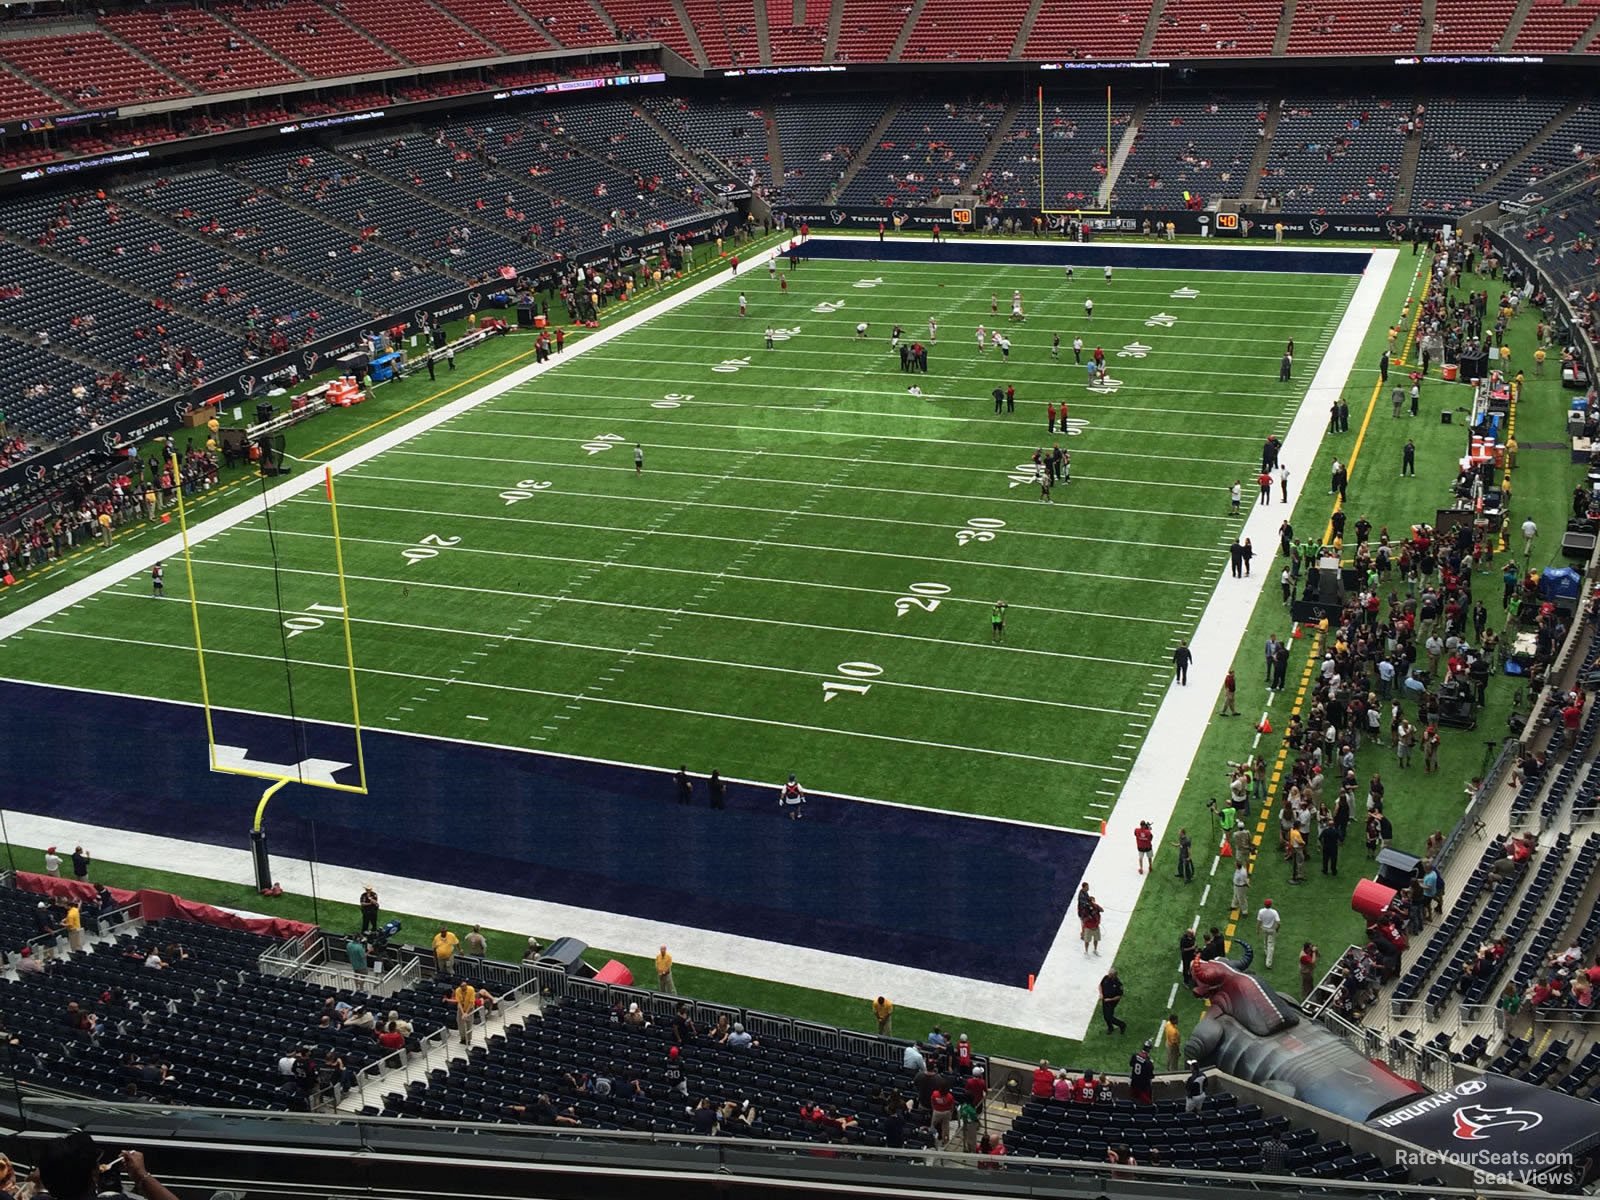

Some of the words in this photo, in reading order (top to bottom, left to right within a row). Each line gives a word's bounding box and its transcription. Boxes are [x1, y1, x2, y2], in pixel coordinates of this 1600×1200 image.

[954, 210, 969, 222] 40
[1219, 215, 1235, 227] 40
[1335, 225, 1380, 233] TEXANS
[433, 304, 464, 318] TEXANS
[324, 342, 355, 359] TEXANS
[1117, 344, 1153, 359] 30
[711, 358, 750, 372] 40
[651, 393, 695, 408] 50
[128, 417, 169, 438] TEXANS
[581, 433, 625, 451] 40
[499, 479, 552, 501] 30
[955, 518, 1007, 542] 30
[401, 533, 462, 559] 20
[895, 582, 951, 612] 20
[282, 602, 348, 630] 10
[822, 661, 884, 695] 10
[1134, 1063, 1142, 1075] 8
[1082, 1087, 1094, 1099] 99
[1100, 1091, 1112, 1101] 99
[1377, 1092, 1458, 1128] HYUNDAI
